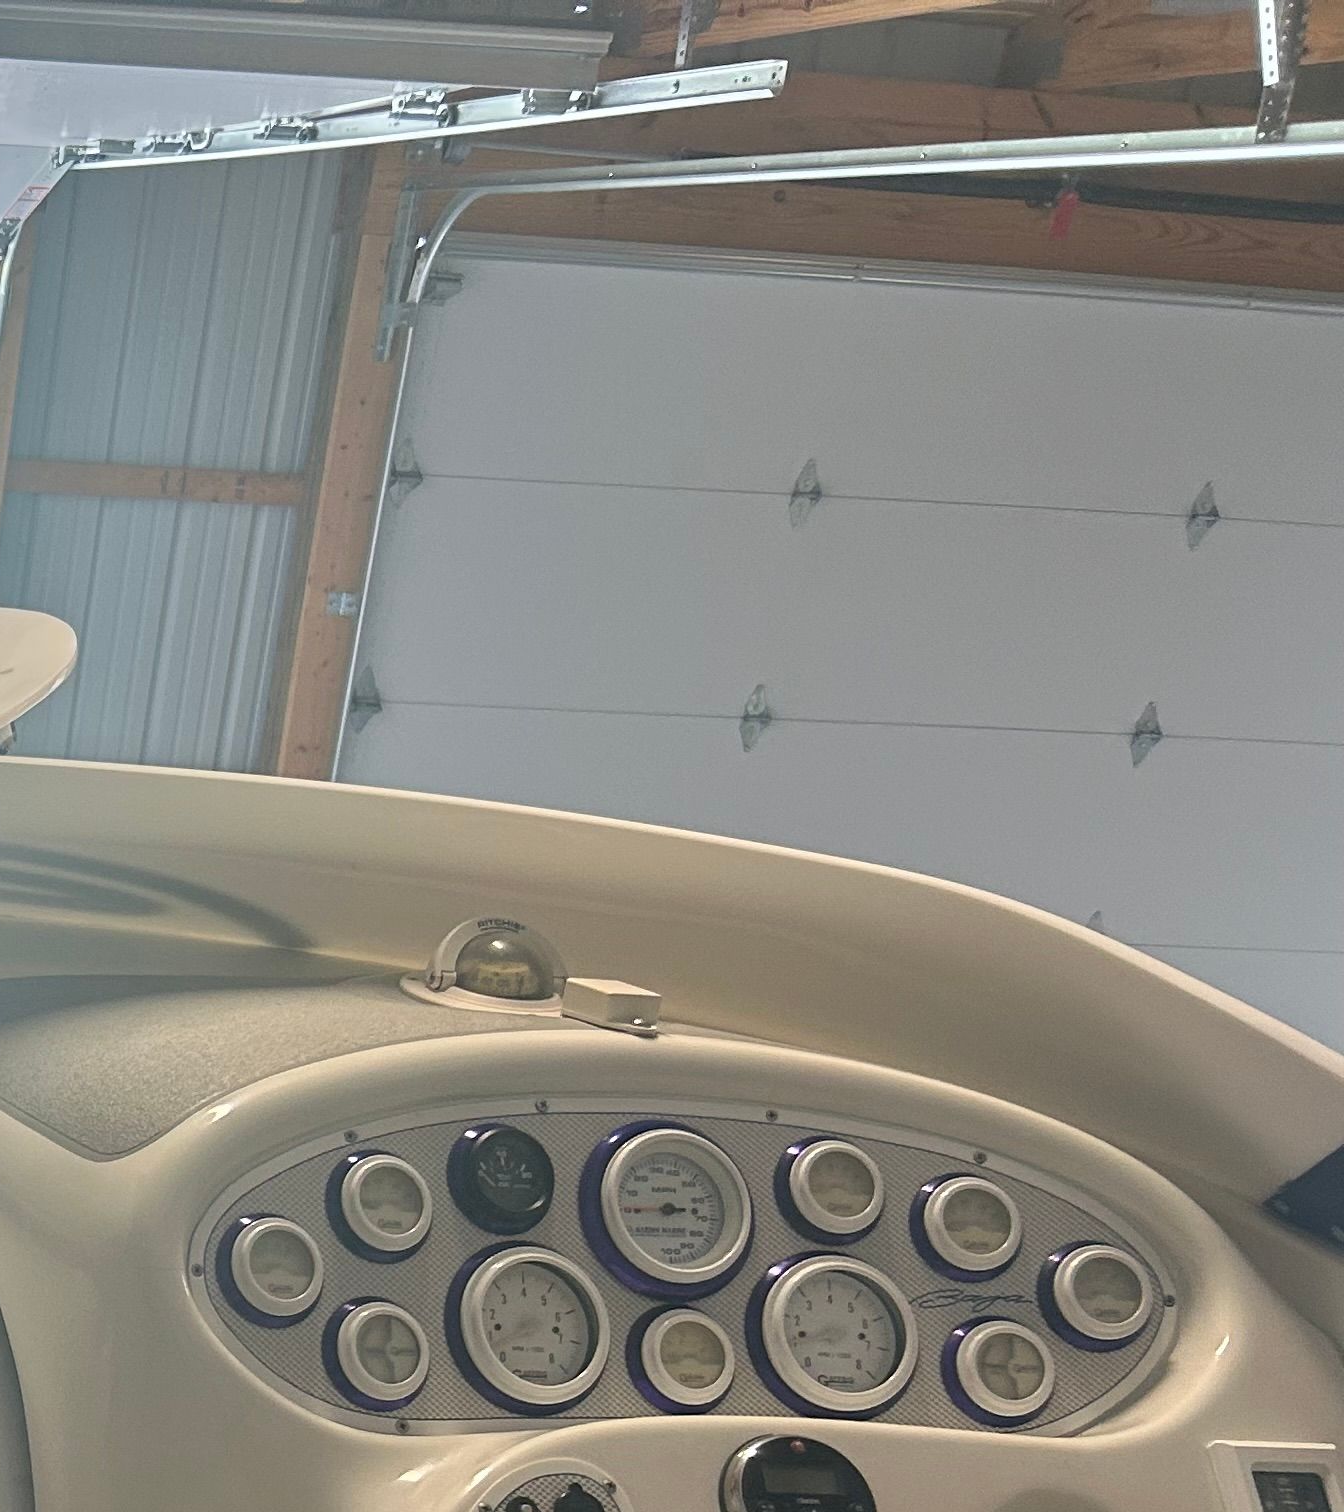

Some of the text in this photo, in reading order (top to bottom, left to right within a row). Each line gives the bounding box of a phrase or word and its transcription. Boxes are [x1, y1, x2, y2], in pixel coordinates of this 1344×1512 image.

[477, 918, 520, 930] RITCHIE
[521, 1287, 527, 1298] 4
[501, 1293, 507, 1304] 3
[541, 1294, 547, 1306] 5
[828, 1295, 833, 1304] 4
[908, 1289, 1032, 1312] Baja
[806, 1300, 812, 1311] 3
[848, 1302, 854, 1313] 5
[489, 1309, 495, 1320] 2
[794, 1315, 800, 1326] 2
[865, 1340, 870, 1351] 7
[500, 1351, 506, 1363] 0
[549, 1353, 555, 1364] 8
[855, 1359, 861, 1370] 8
